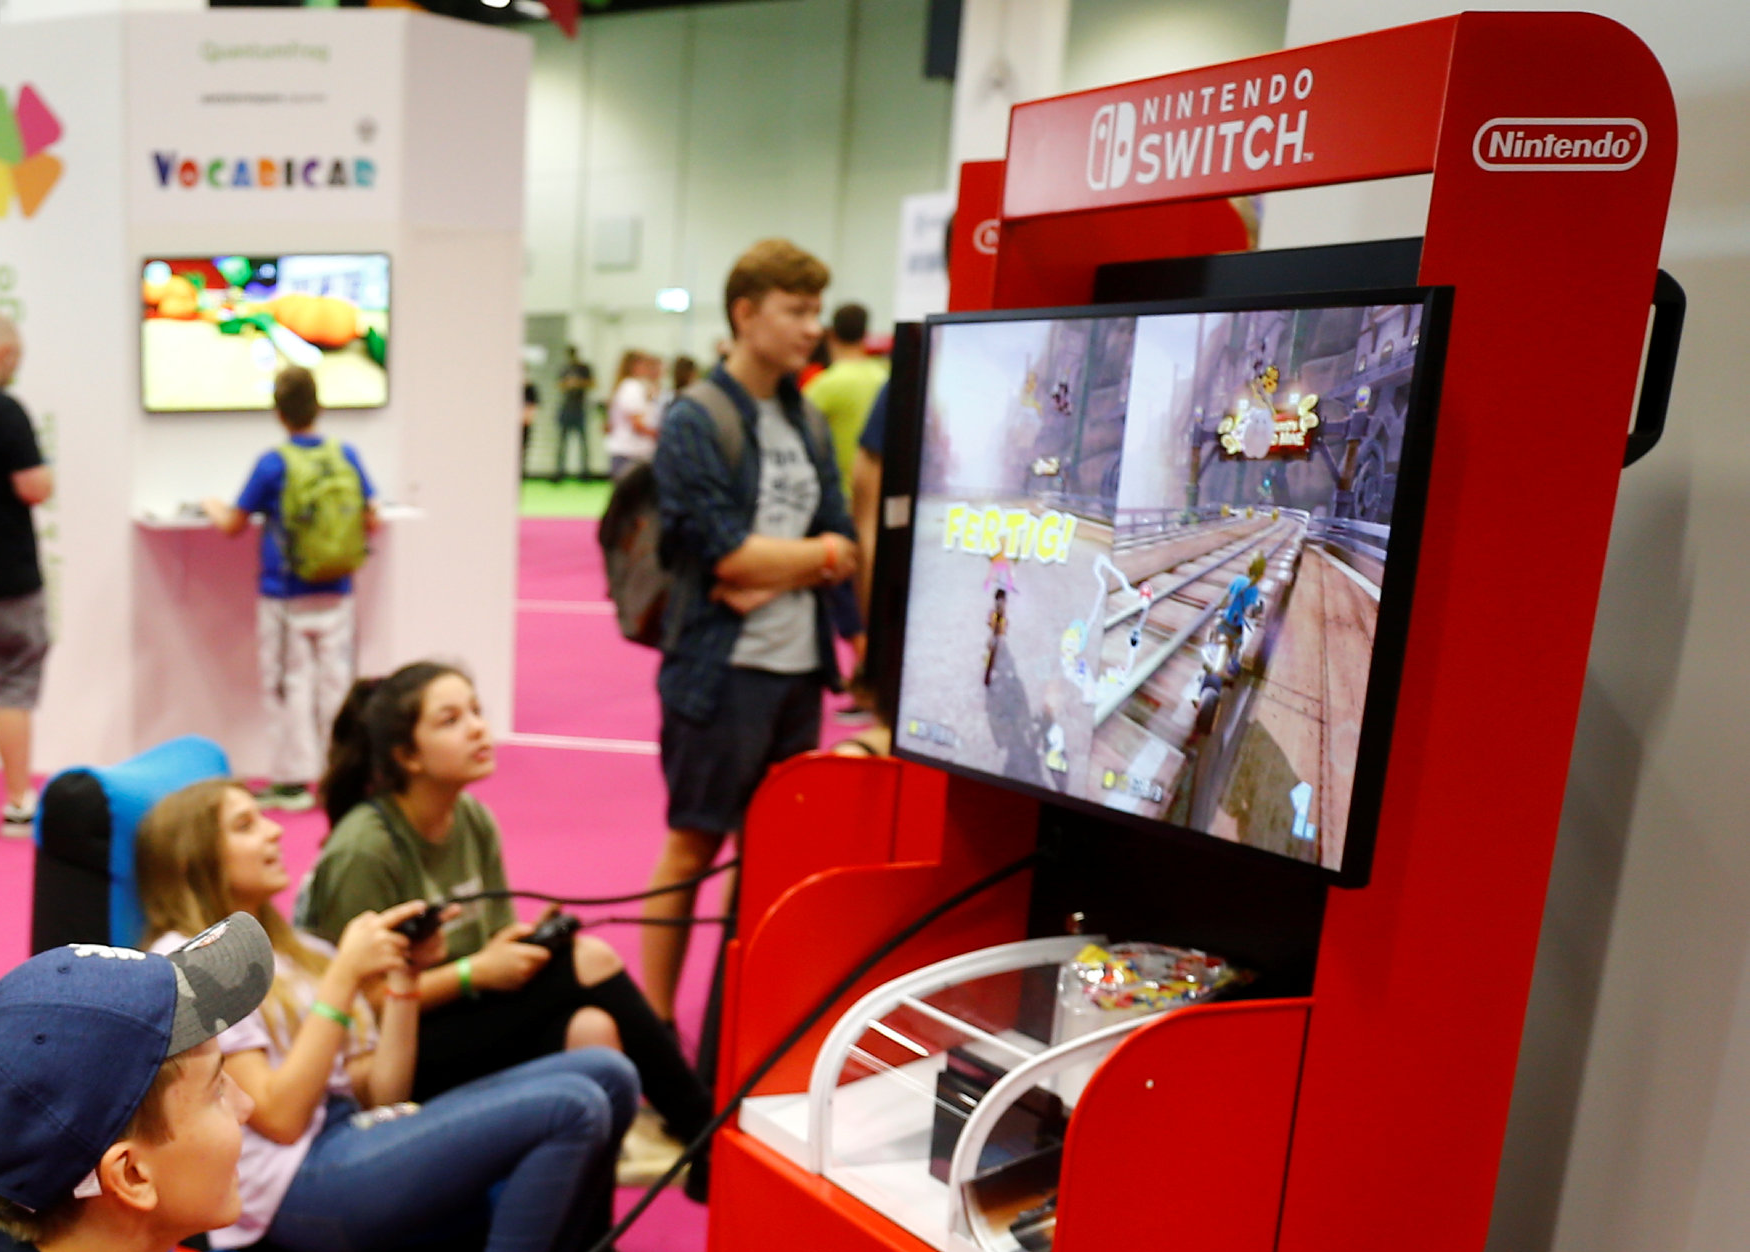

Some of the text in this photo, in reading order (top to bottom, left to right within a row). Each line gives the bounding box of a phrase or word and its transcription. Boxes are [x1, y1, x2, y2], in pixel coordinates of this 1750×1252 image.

[1142, 68, 1314, 125] NINTENDO
[1135, 110, 1309, 184] SWITCH
[1488, 131, 1631, 158] Nintendo
[945, 501, 1076, 563] FERTIG!
